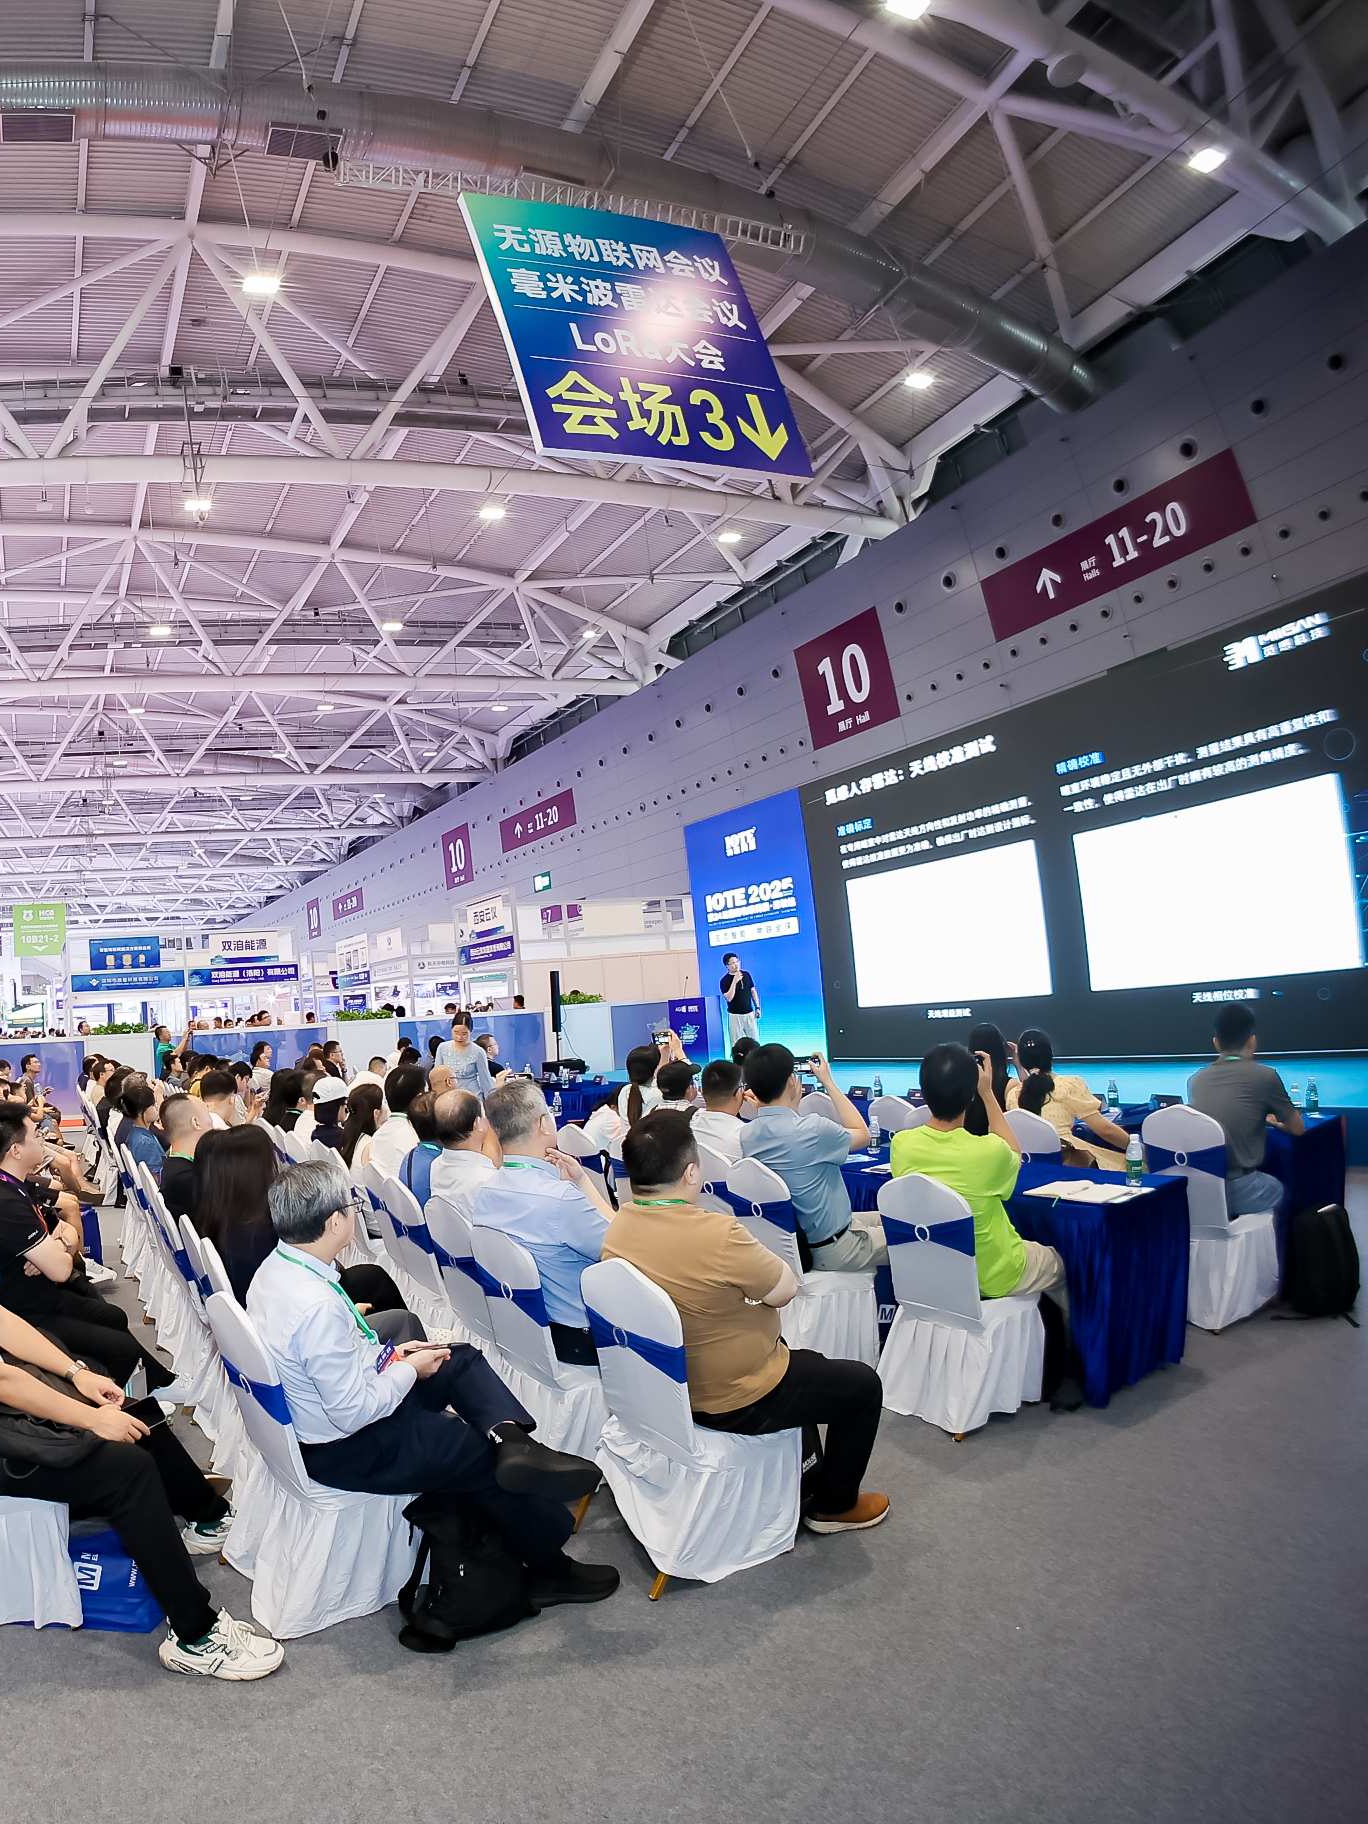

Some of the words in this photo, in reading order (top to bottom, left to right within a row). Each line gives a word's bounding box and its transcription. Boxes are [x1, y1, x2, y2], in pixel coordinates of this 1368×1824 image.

[492, 223, 730, 287] 无源物联网会议
[544, 370, 735, 452] 会场3
[1104, 501, 1187, 568] 11-20
[1083, 568, 1101, 582] Halls
[817, 643, 871, 716] 10
[855, 710, 871, 726] Hall
[534, 805, 559, 831] 11-20
[448, 838, 466, 874] 10
[705, 887, 747, 912] IOTE
[747, 876, 793, 904] 2025
[309, 906, 318, 930] 10
